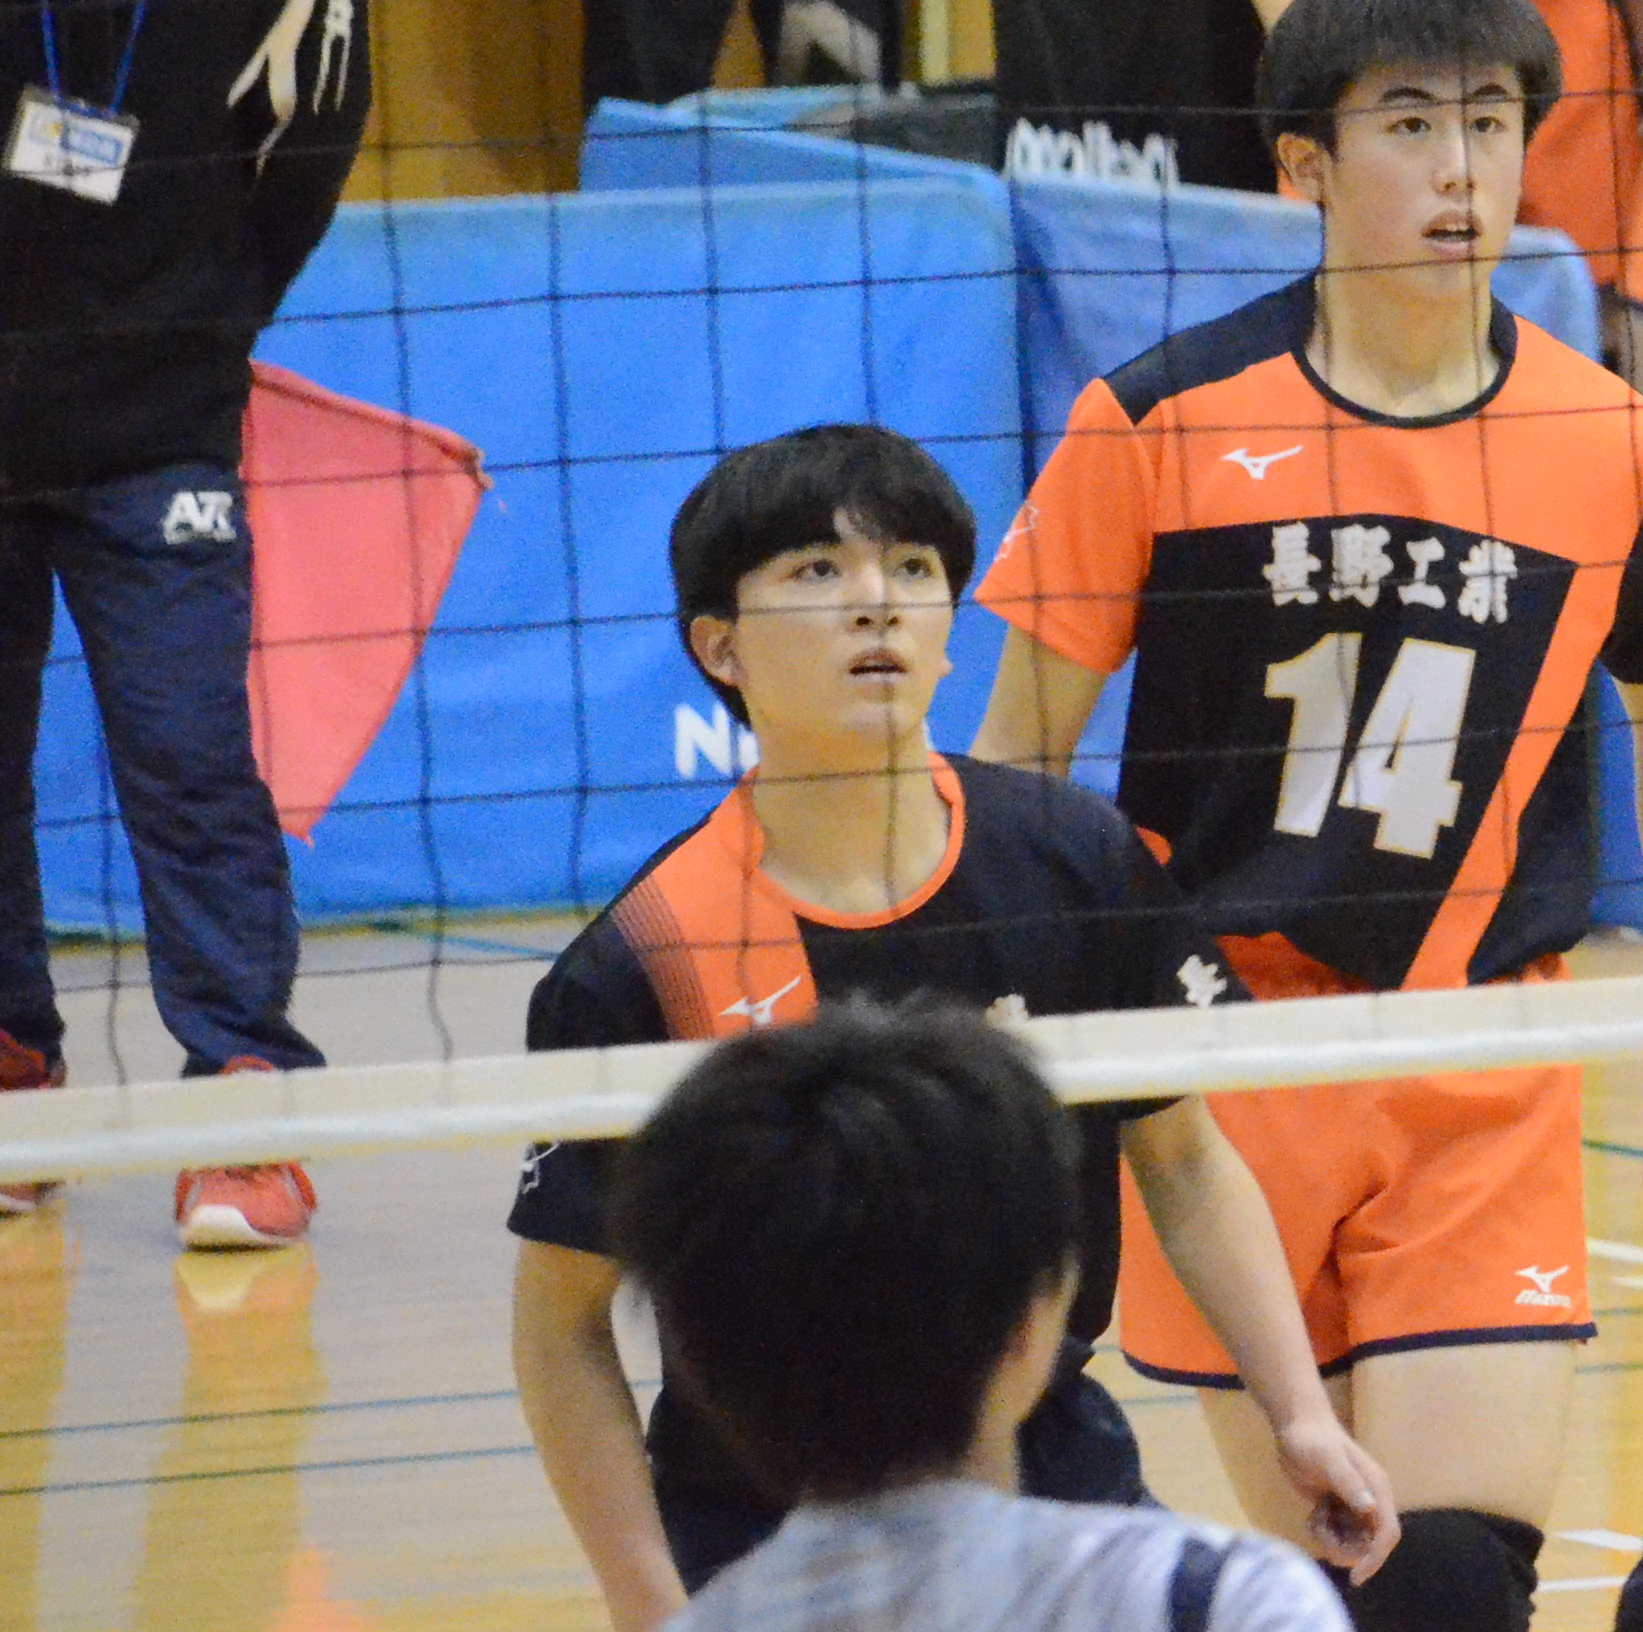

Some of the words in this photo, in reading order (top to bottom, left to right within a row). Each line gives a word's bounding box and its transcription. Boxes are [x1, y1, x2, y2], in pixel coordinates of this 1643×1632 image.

[1262, 520, 1518, 624] 長野工業
[1263, 631, 1477, 859] 14
